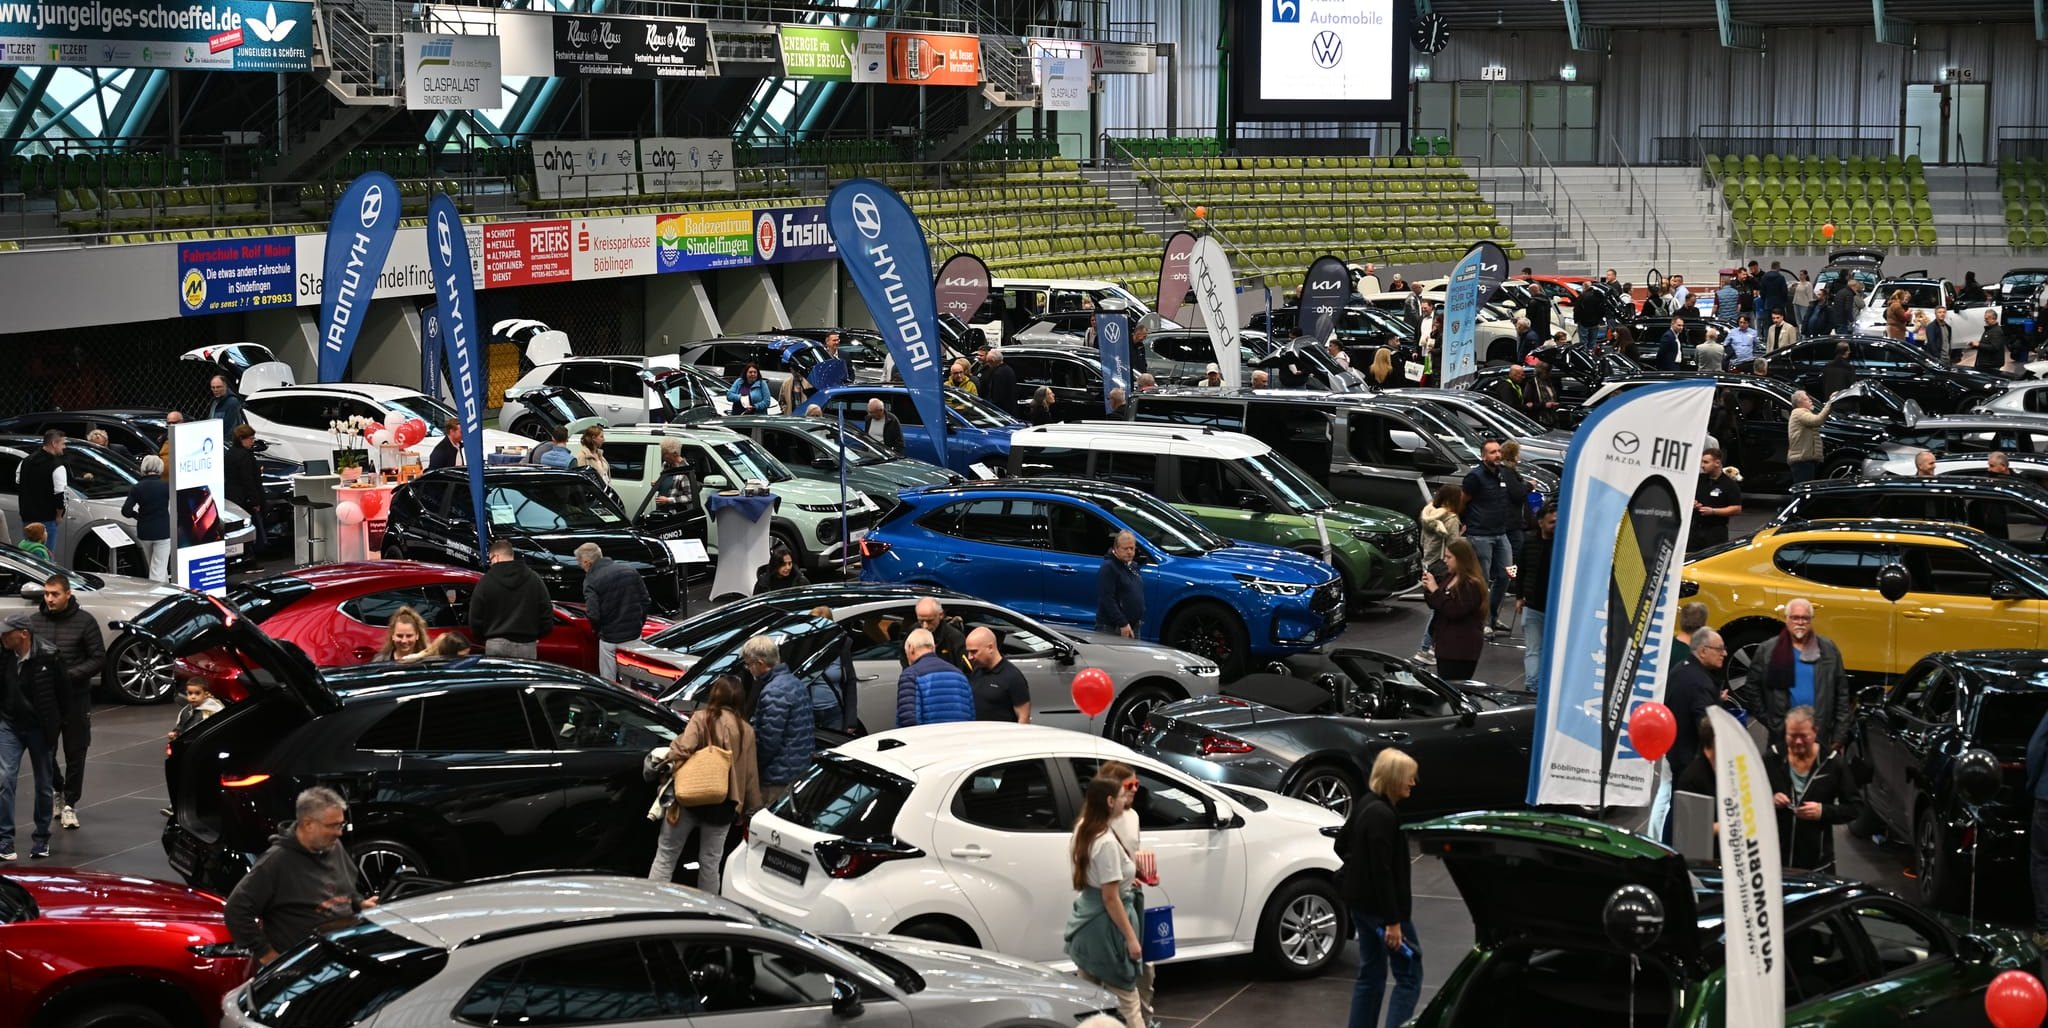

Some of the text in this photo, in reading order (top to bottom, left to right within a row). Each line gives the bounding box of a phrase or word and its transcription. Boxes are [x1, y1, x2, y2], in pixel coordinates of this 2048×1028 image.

[1310, 10, 1383, 25] Automobile
[784, 37, 818, 51] ENERGIE
[237, 47, 271, 57] JUNGEILGES
[278, 47, 306, 58] SCHÖFFEL
[785, 52, 845, 68] DEINEN ERFOLG
[423, 77, 480, 92] GLASPALAST
[685, 217, 750, 235] Badezentrum
[490, 229, 515, 239] SCHROTT
[530, 228, 569, 253] PETERS
[491, 239, 515, 249] METALLE
[593, 234, 651, 252] Kreissparkasse
[686, 236, 749, 256] Sindelfingen
[183, 244, 292, 263] Fahrschule Rolf Maier
[491, 250, 521, 260] ALTPAPIER
[206, 262, 291, 280] Die etwas andere Fahrschule
[491, 260, 525, 271] CONTAINER-
[594, 256, 634, 274] Böblingen
[492, 272, 512, 282] DIENST
[1174, 272, 1188, 281] ahg
[228, 282, 235, 294] in
[299, 273, 323, 296] Sta
[261, 293, 292, 305] 879933
[949, 300, 967, 312] ahg
[869, 244, 932, 371] HYUNDAI
[1317, 305, 1333, 316] ahg
[446, 273, 478, 434] HYUNDAI
[1605, 454, 1640, 466] MAZDA
[1651, 437, 1692, 471] FIAT
[179, 457, 212, 473] MEILING
[1608, 544, 1669, 731] AUTOMOBILFORUM STAIGER
[1551, 763, 1590, 774] Böblingen
